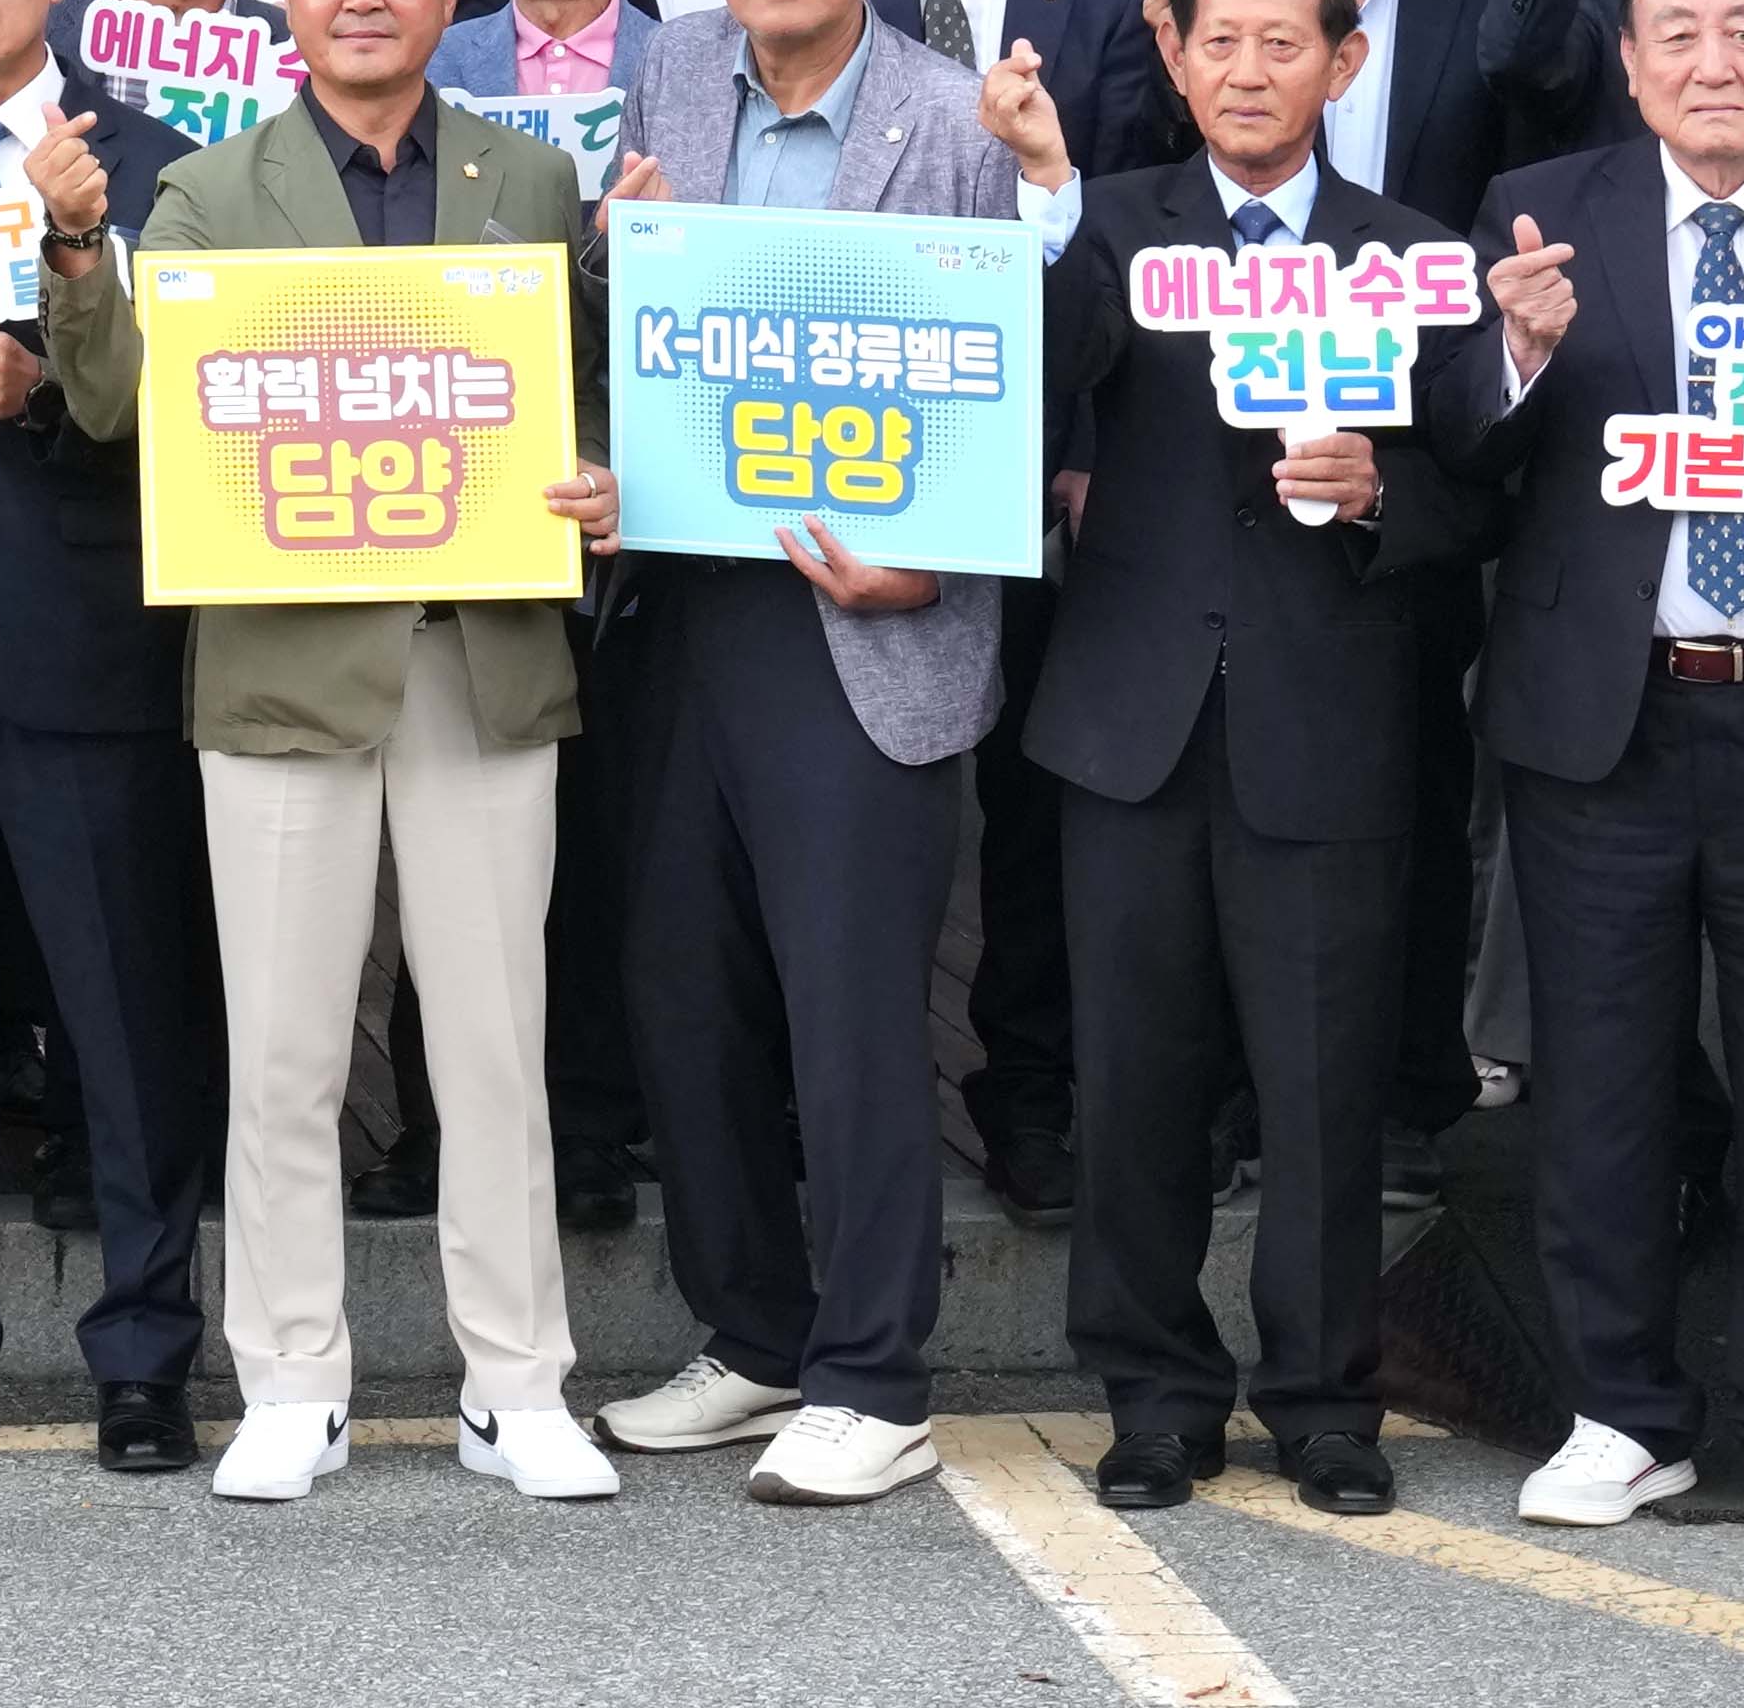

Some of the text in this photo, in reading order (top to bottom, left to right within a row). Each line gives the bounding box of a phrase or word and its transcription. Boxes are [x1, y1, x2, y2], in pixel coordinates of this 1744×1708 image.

[89, 8, 261, 87] 에너지
[1141, 254, 1472, 321] 에너지 수도
[202, 354, 510, 424] 활력 넘치는
[640, 312, 1001, 395] K-미식 장류벨트
[1226, 327, 1403, 413] 전남
[270, 437, 453, 539] 담양
[732, 400, 912, 505] 담양
